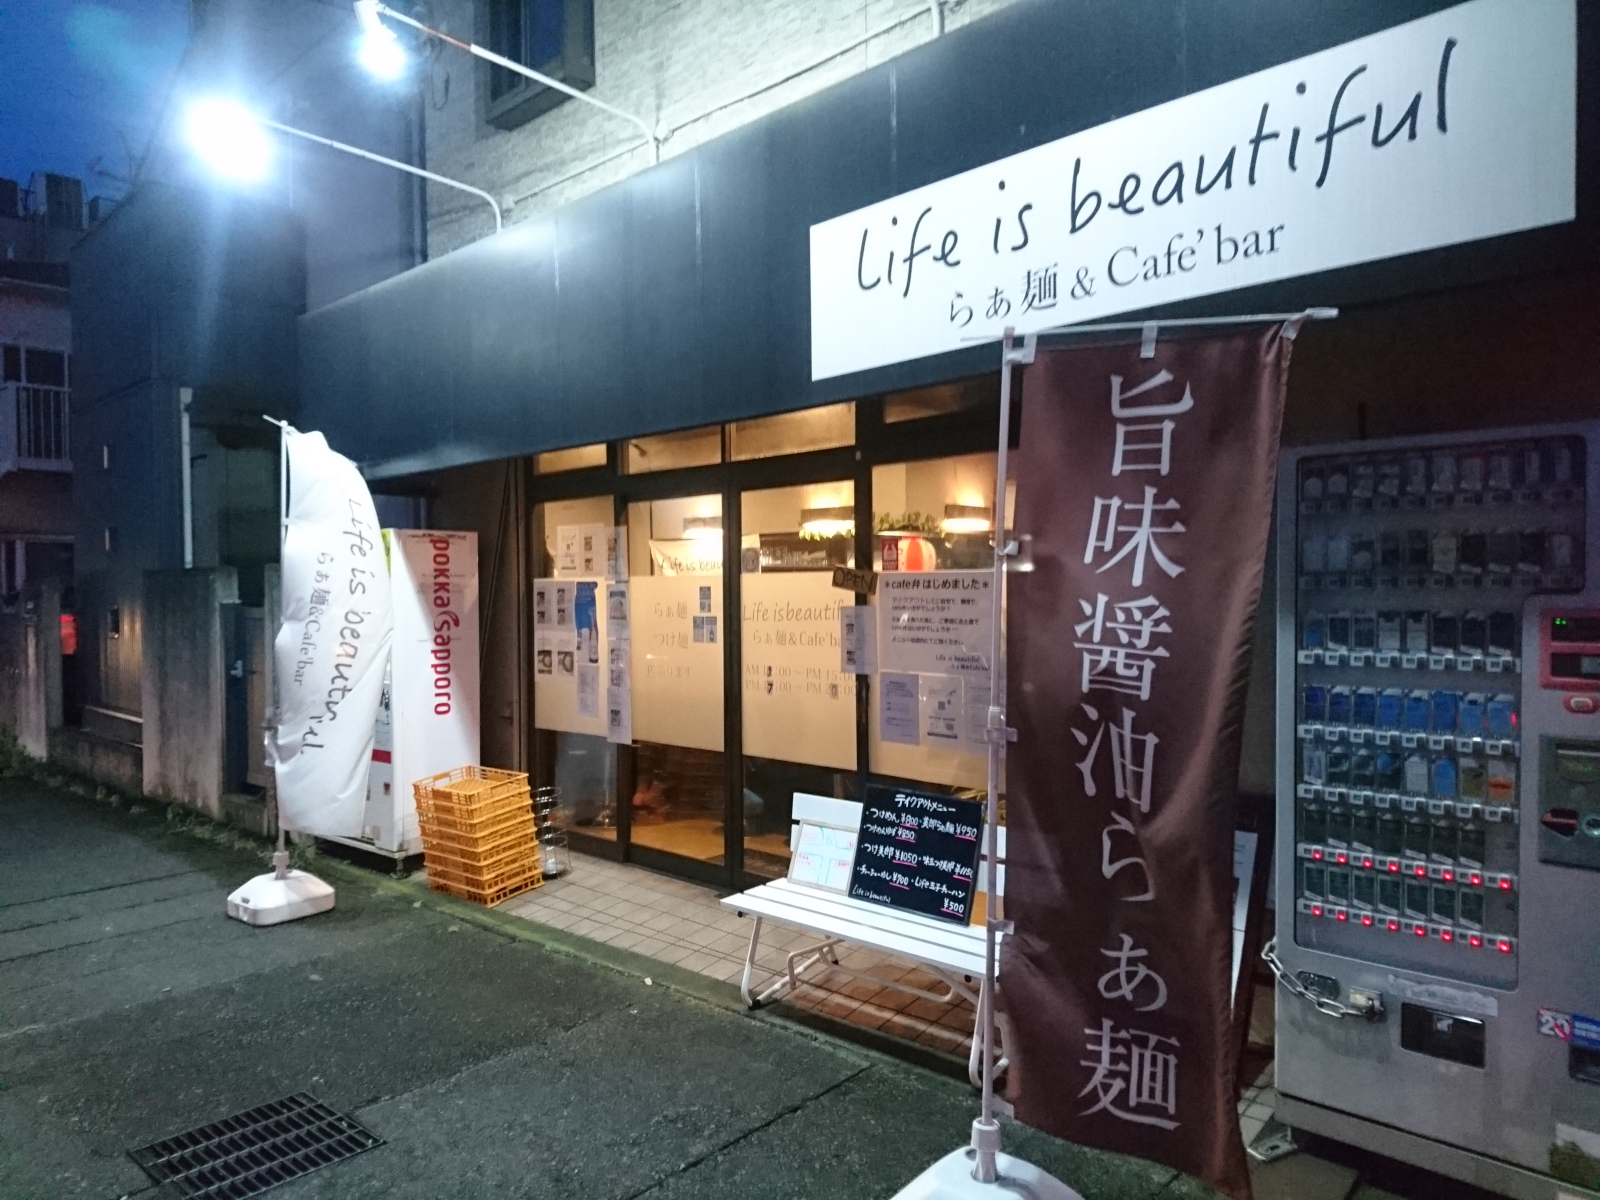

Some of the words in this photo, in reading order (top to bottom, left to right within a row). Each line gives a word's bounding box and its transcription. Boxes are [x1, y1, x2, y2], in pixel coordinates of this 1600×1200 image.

[992, 180, 1033, 254] is
[1069, 37, 1458, 234] beautiful
[342, 498, 374, 557] Life
[348, 567, 376, 595] is
[833, 566, 875, 593] OPEN
[743, 602, 770, 621] Life
[894, 793, 957, 812] テイクアウトメニュー
[897, 827, 915, 840] ¥850
[901, 812, 919, 826] ¥800
[955, 822, 977, 838] ¥950
[894, 849, 918, 864] ¥1050
[943, 897, 965, 914] ¥500
[1540, 1015, 1570, 1038] 20
